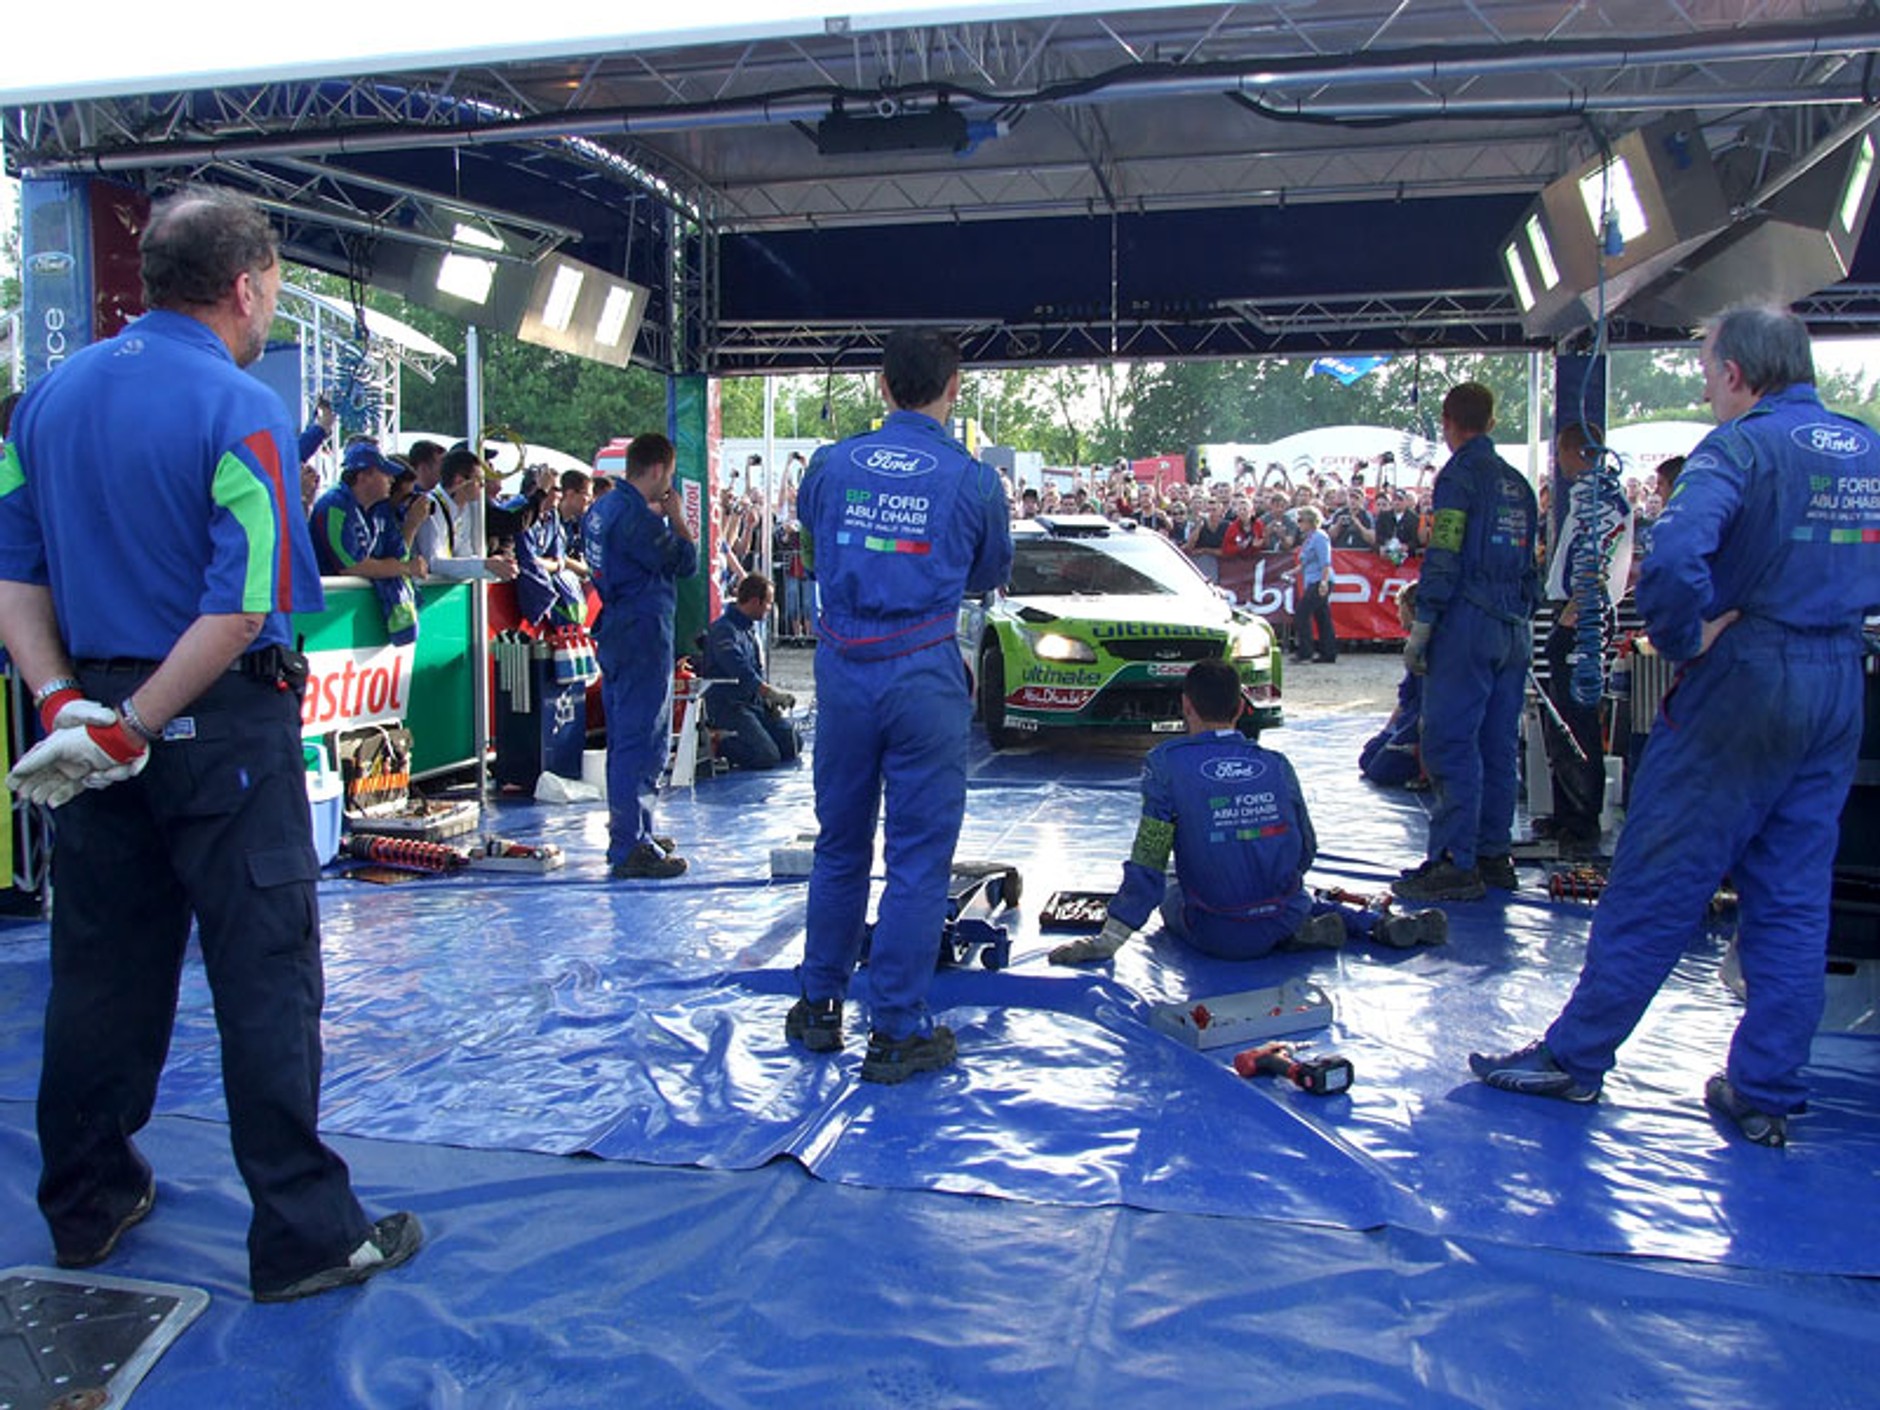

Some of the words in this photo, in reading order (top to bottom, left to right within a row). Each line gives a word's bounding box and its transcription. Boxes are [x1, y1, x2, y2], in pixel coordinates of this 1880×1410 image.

[44, 308, 65, 371] nce
[1811, 427, 1861, 453] Ford
[867, 449, 920, 472] Ford
[1838, 476, 1880, 494] FORD
[845, 488, 872, 502] BP
[879, 493, 930, 511] FORD
[1809, 493, 1839, 509] ABU
[1842, 495, 1880, 509] DHAB
[845, 505, 877, 519] ABU
[881, 510, 927, 525] DHABI
[1022, 665, 1101, 686] ultimate
[301, 655, 402, 726] astrol
[1215, 762, 1254, 778] Ford
[1234, 791, 1275, 806] FORD
[1212, 808, 1239, 820] ABU
[1240, 803, 1278, 816] DHABI
